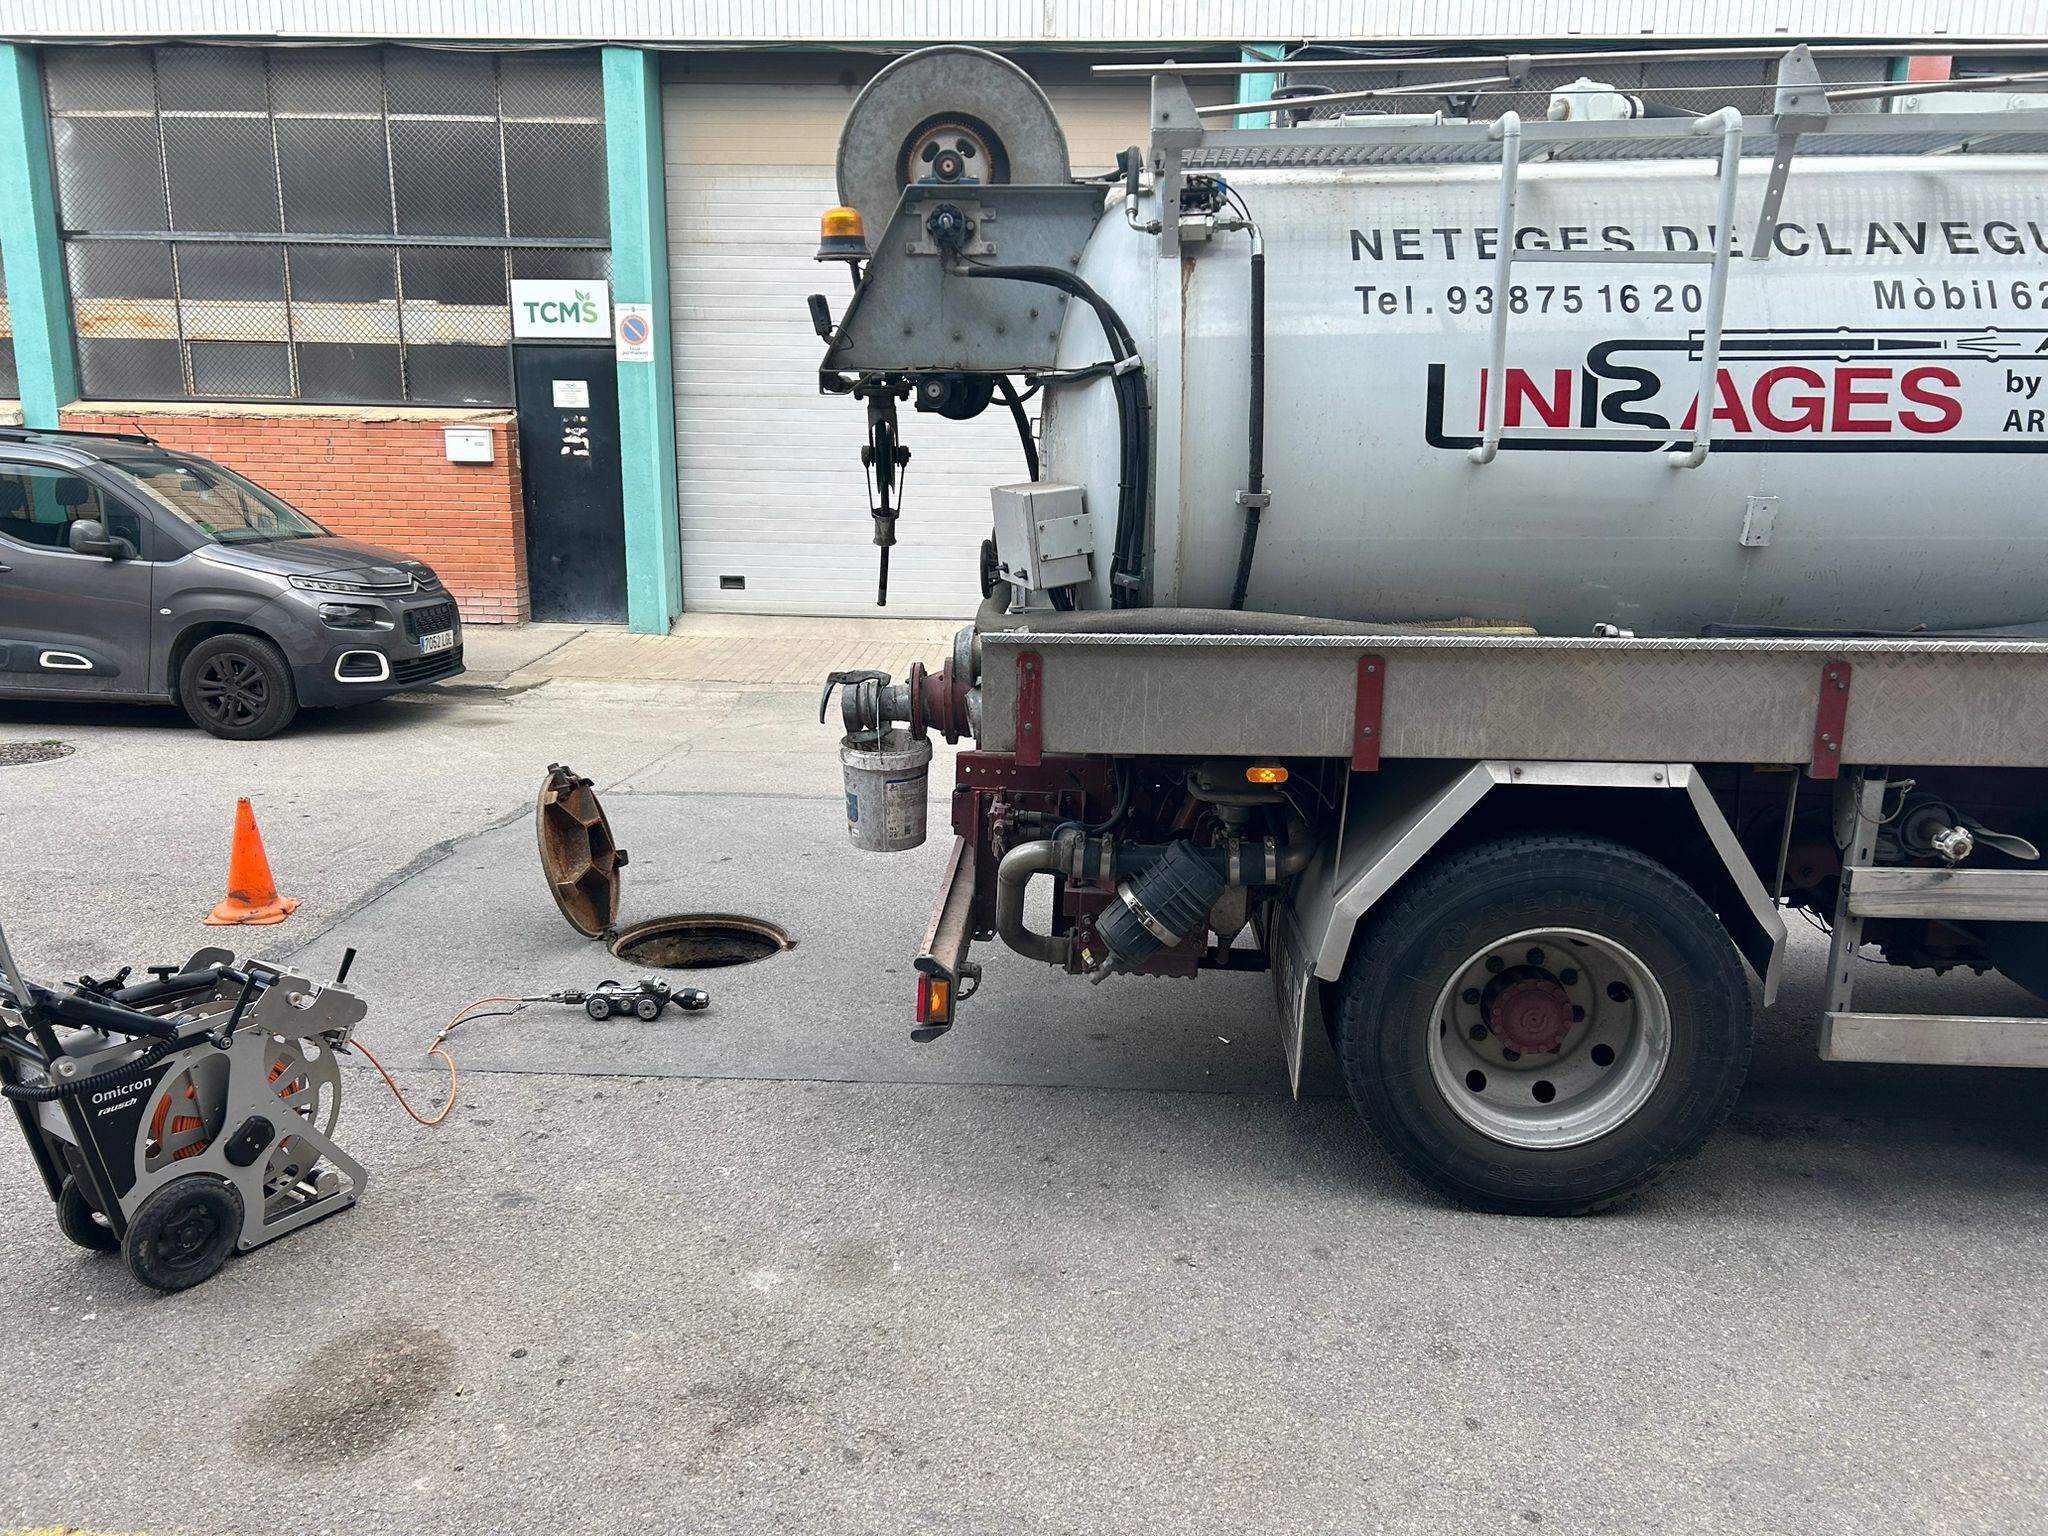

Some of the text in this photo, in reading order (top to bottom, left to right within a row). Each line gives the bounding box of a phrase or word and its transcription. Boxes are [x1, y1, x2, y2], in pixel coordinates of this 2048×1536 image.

[1350, 225, 1635, 261] NETEGES
[1354, 285, 1433, 315] Tel.
[1873, 278, 1998, 310] Mòbil
[523, 301, 598, 324] TCMS
[2006, 369, 2042, 400] by
[92, 1078, 152, 1104] Omicron
[98, 1097, 137, 1117] rausch
